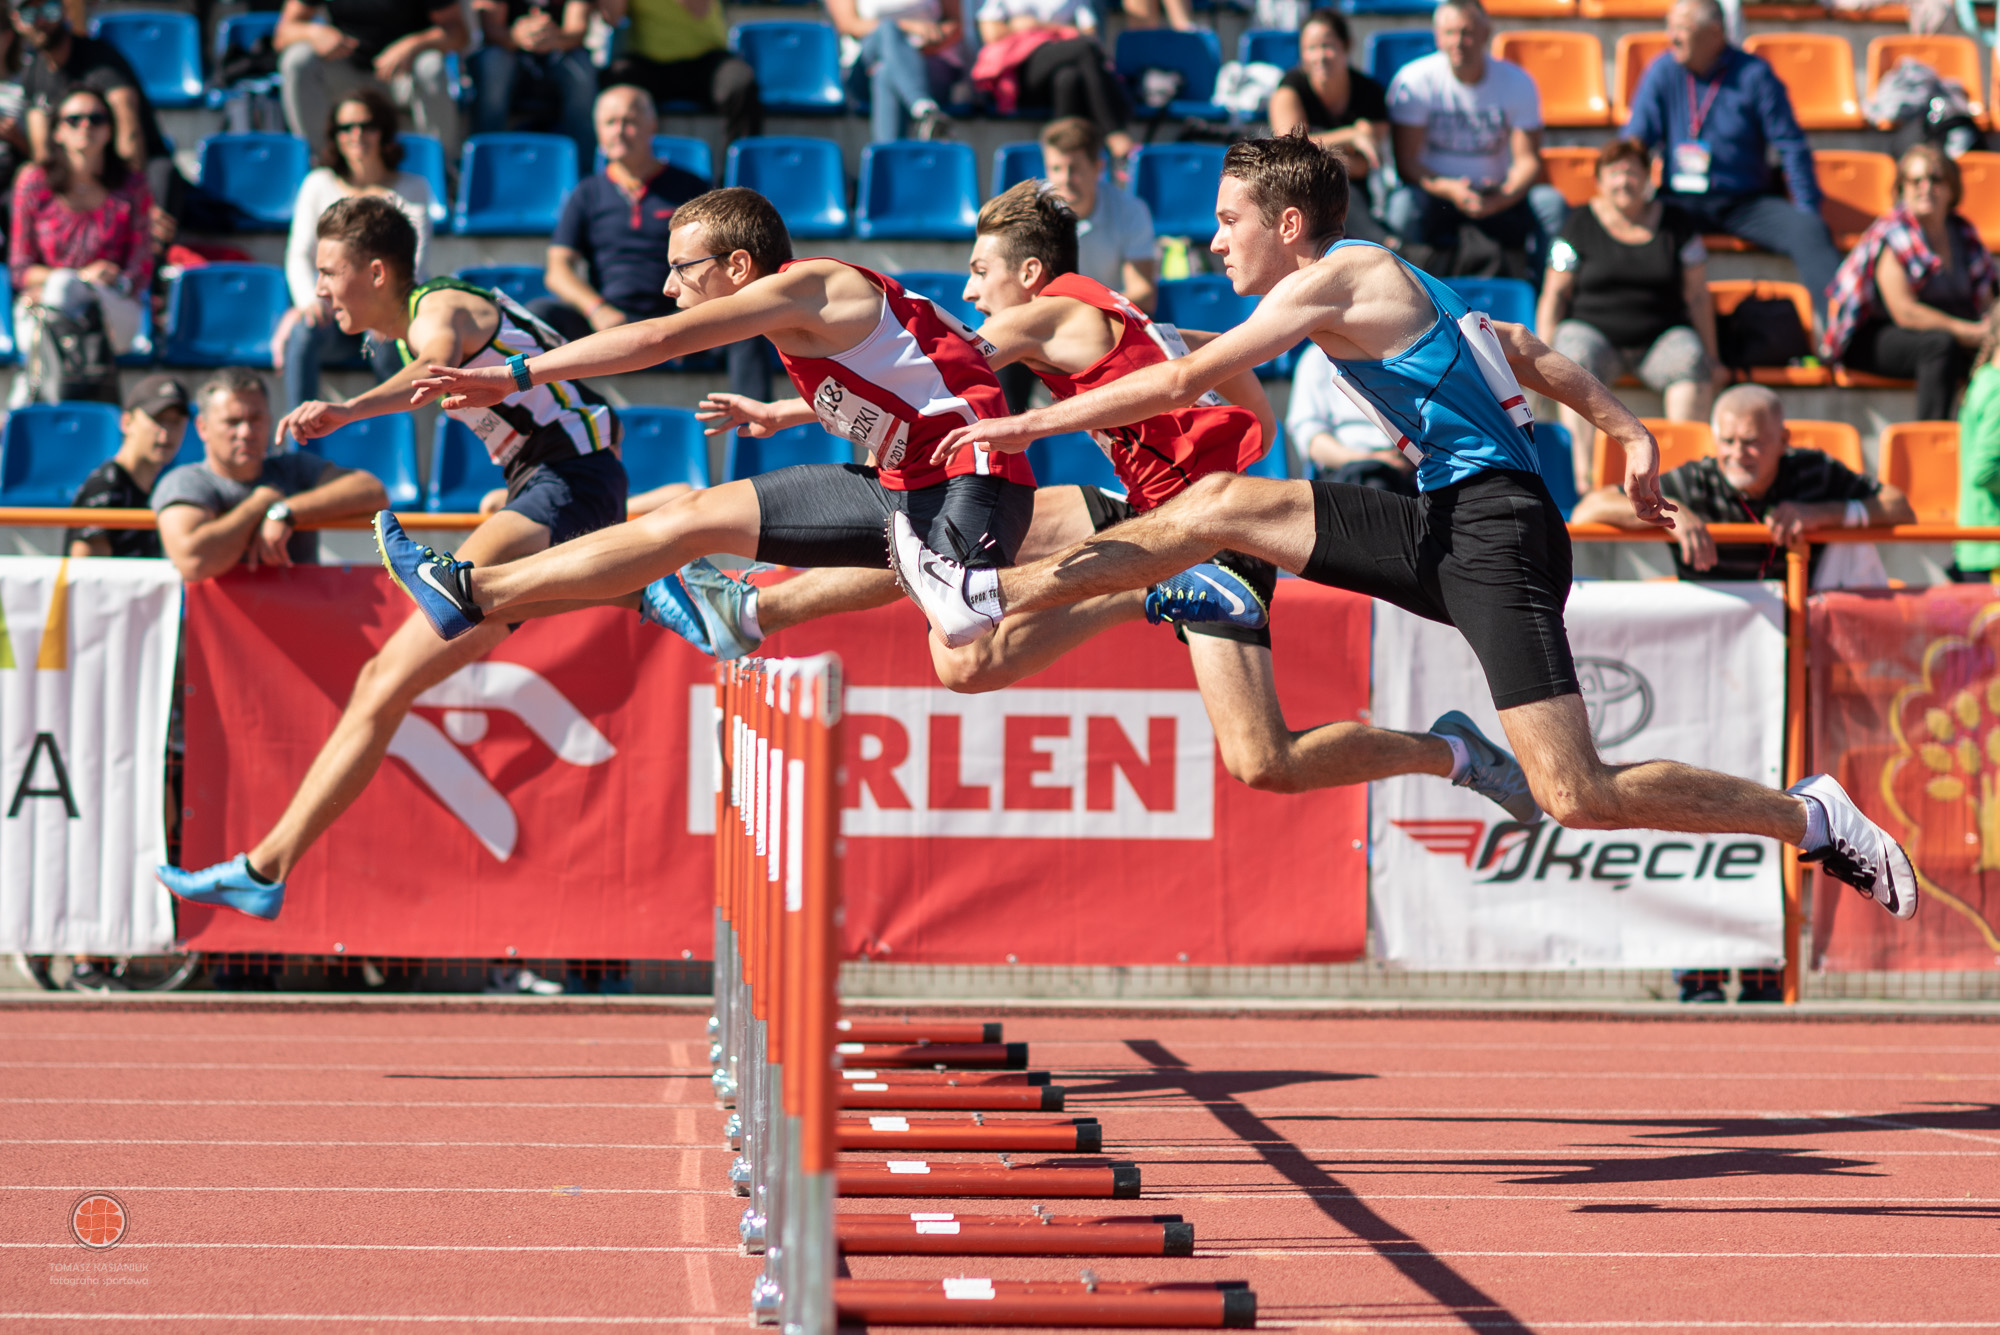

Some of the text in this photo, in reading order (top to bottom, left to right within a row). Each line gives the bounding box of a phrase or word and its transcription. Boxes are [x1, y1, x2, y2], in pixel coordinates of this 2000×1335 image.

[890, 438, 907, 463] 2019
[6, 731, 81, 818] A
[843, 713, 1179, 813] RLEN
